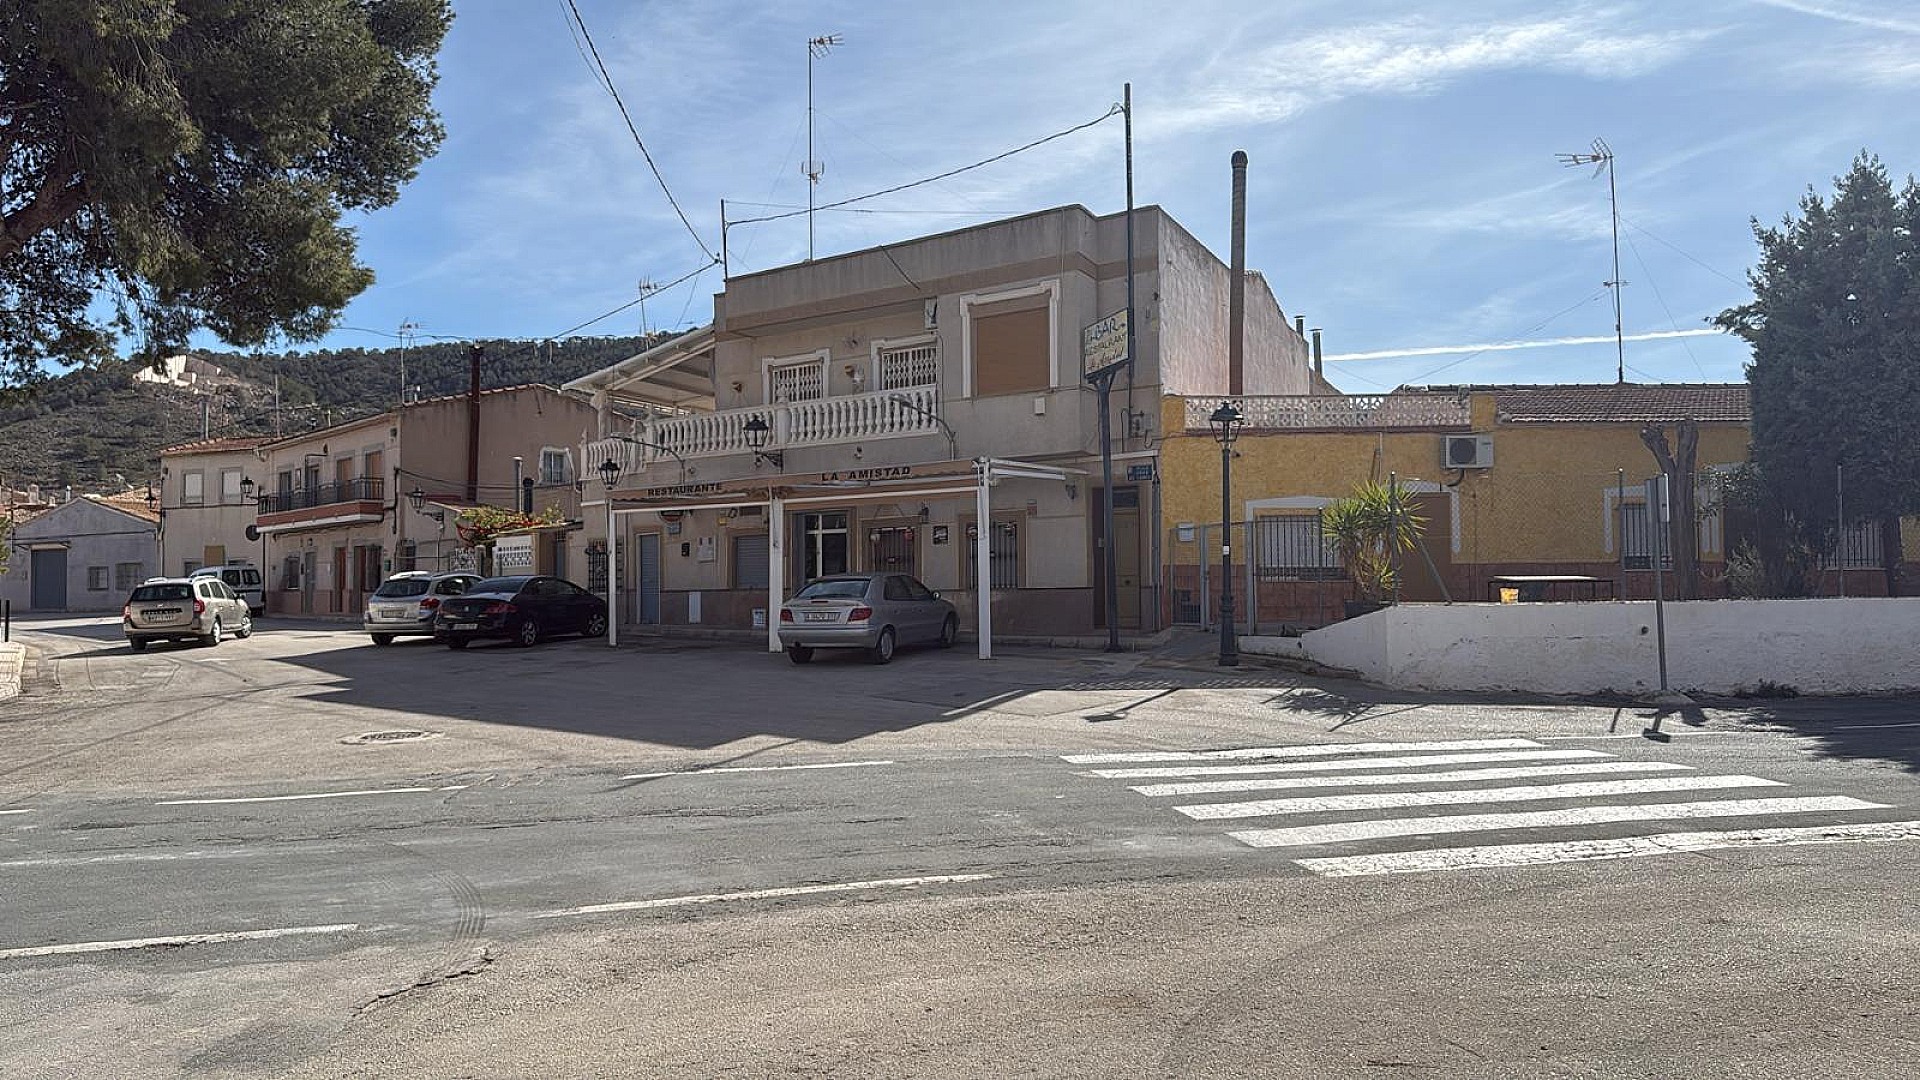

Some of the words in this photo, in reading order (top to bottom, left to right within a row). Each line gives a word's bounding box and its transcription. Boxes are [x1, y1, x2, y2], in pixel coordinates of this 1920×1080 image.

[821, 472, 838, 481] LA
[849, 466, 911, 481] AMISTAD
[647, 482, 722, 496] RESTAURANTE
